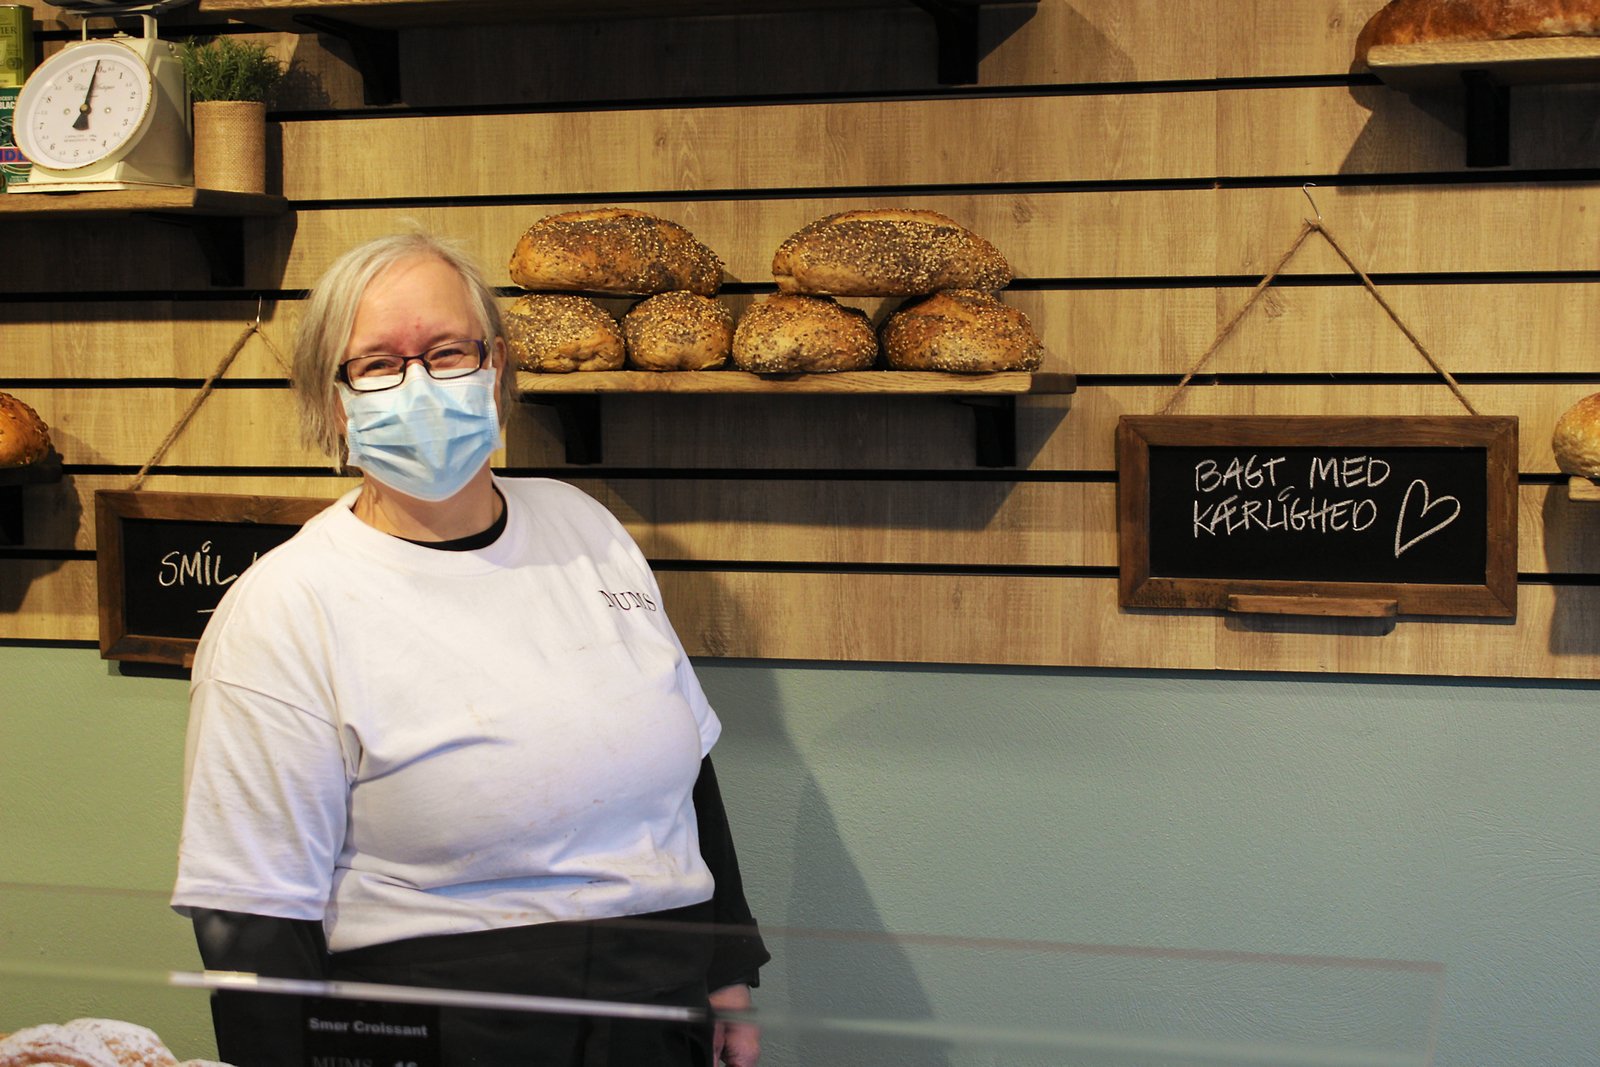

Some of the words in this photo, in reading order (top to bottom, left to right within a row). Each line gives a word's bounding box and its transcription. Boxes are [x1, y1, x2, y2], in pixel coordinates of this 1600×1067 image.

[1195, 455, 1286, 492] BAGT
[1310, 455, 1391, 489] MED
[353, 1020, 429, 1038] Croissant
